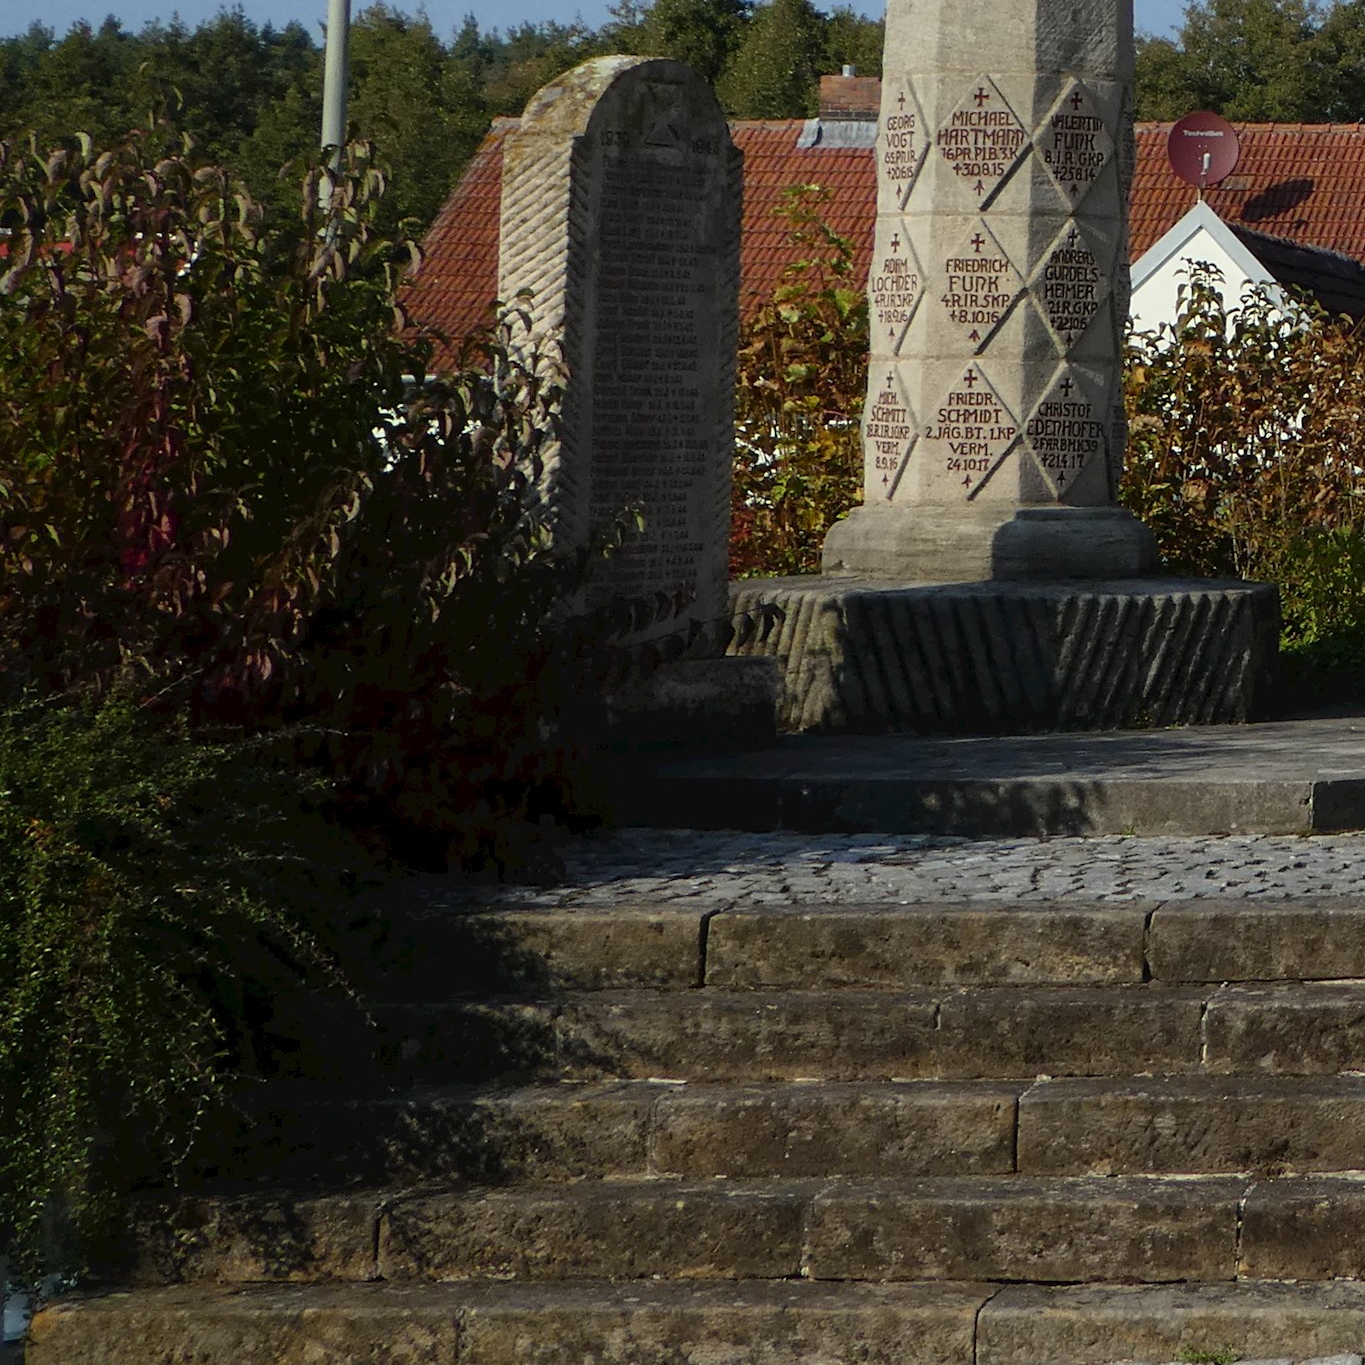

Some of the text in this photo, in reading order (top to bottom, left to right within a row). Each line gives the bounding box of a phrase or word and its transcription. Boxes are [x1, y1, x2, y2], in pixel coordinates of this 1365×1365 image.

[887, 114, 915, 131] GEORG
[952, 111, 1014, 126] MICHAEL
[1051, 114, 1103, 131] VALENTIN
[886, 131, 915, 148] VOGT
[937, 128, 1024, 146] HARTMANN
[1054, 132, 1096, 151] FUNK
[883, 258, 907, 273] ADAM
[946, 258, 1008, 273] FRIEDRICH
[1050, 249, 1096, 265] ANDREAS
[872, 274, 917, 292] LOCHNER
[949, 275, 1000, 293] FUNK
[1044, 283, 1094, 300] HEIMER
[948, 392, 997, 406] FRIEDR.
[871, 405, 907, 423] SCHMITT
[937, 408, 1003, 424] SCHMIDT
[1039, 402, 1092, 418] CHRISTOF
[1027, 419, 1105, 438] EDENHOFER
[876, 441, 901, 456] VERM.
[949, 442, 993, 456] VERM.
